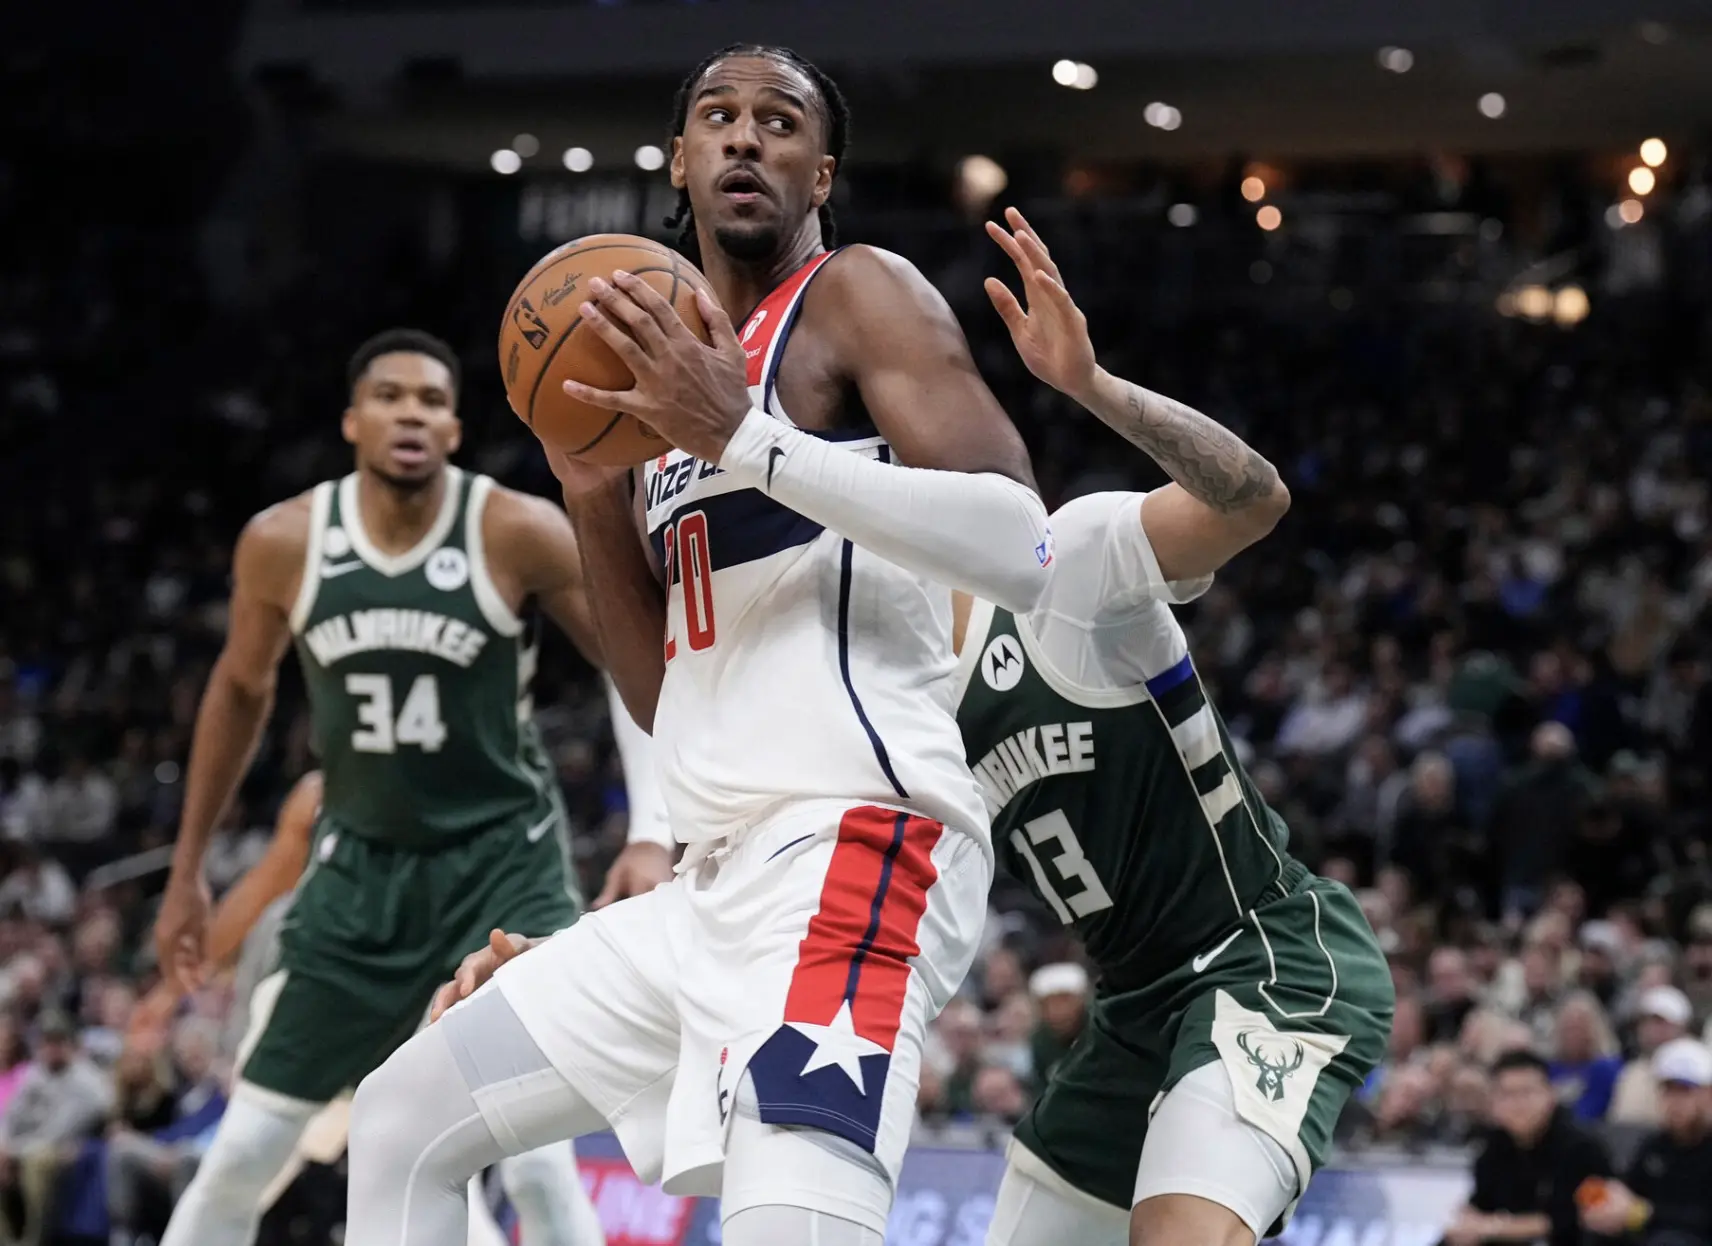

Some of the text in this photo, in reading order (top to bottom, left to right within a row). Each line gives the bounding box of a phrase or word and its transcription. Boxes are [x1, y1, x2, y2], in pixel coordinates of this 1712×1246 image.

[305, 608, 488, 668] MILWAUKEE
[345, 673, 447, 754] 34
[1009, 808, 1114, 925] 13
